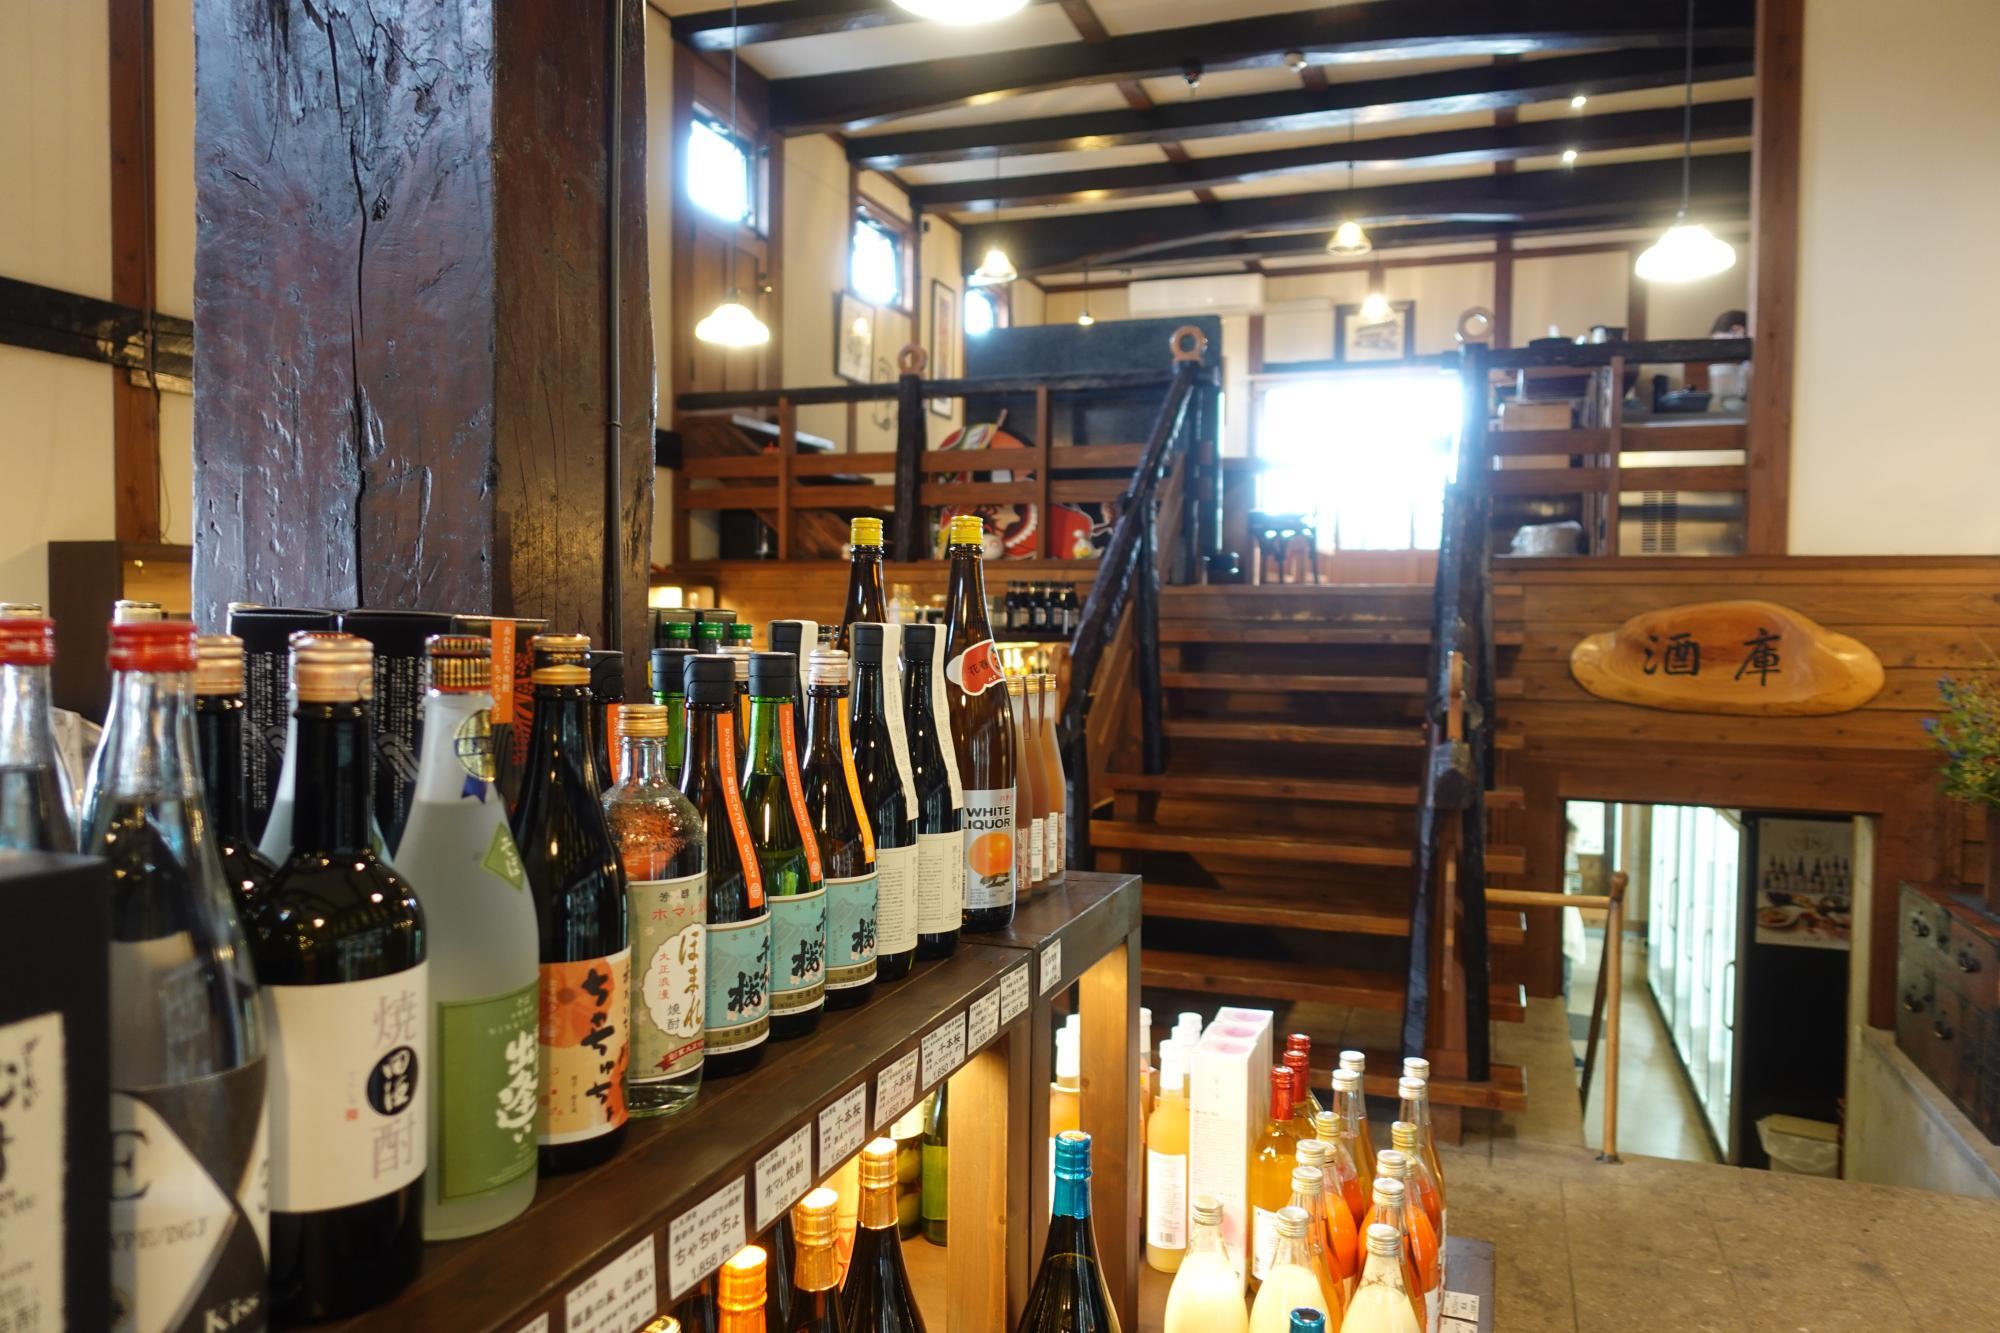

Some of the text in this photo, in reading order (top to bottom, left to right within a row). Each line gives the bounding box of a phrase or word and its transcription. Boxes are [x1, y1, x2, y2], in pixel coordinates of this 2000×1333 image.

[1642, 627, 1782, 686] 酒庫
[966, 806, 1011, 817] WHITE
[678, 930, 702, 1028] ほまれ
[667, 1003, 681, 1030] 焼酎
[950, 1057, 955, 1067] 円
[835, 1102, 860, 1130] 千本桜
[849, 1136, 855, 1148] 円
[765, 1159, 803, 1198] ホマレ焼酎
[674, 1210, 739, 1268] ちゃちゅちょ
[721, 1243, 729, 1258] 円
